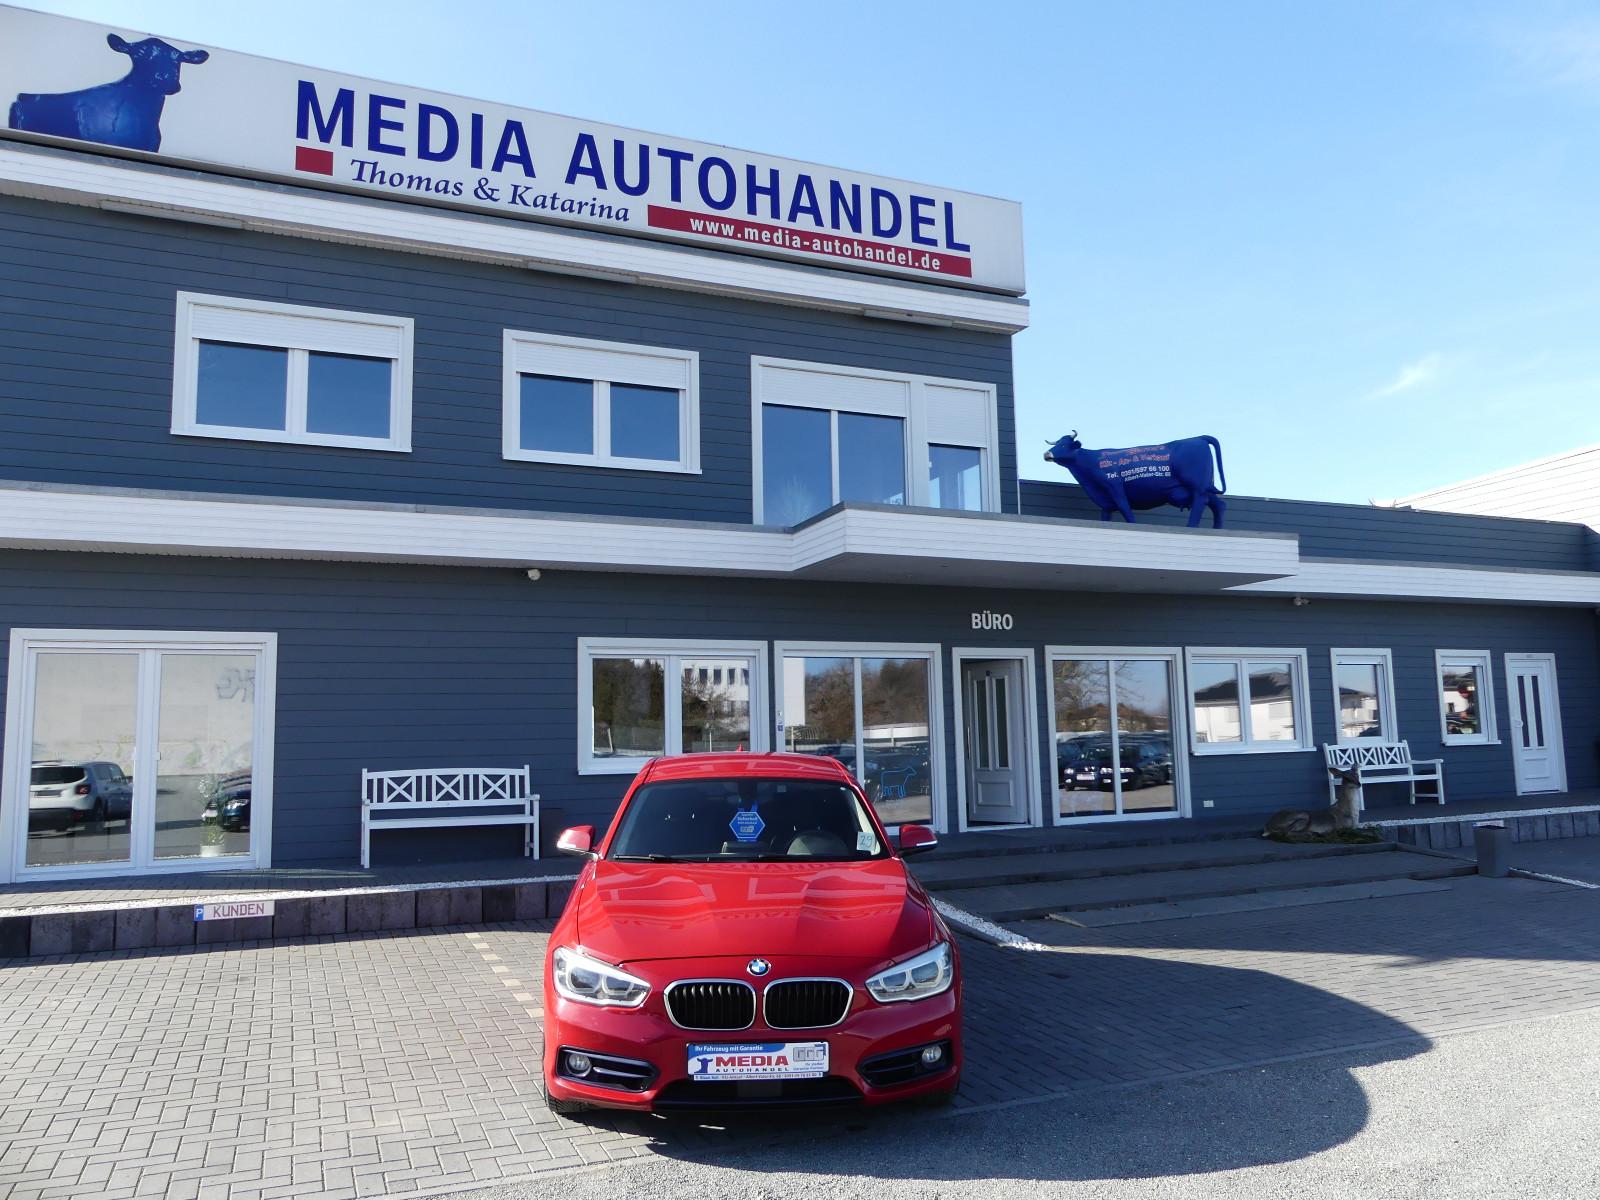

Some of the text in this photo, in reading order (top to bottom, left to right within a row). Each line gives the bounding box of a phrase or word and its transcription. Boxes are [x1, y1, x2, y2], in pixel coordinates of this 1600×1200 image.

[296, 79, 971, 253] MEDIA AUTOHANDEL
[350, 158, 630, 222] Thomas & Katarina
[689, 216, 942, 271] www.media-autohandel.de
[971, 610, 1013, 630] BÜRO
[213, 903, 265, 918] KUNDEN
[703, 1045, 729, 1053] Fahrzeug
[715, 1055, 789, 1067] MEDIA
